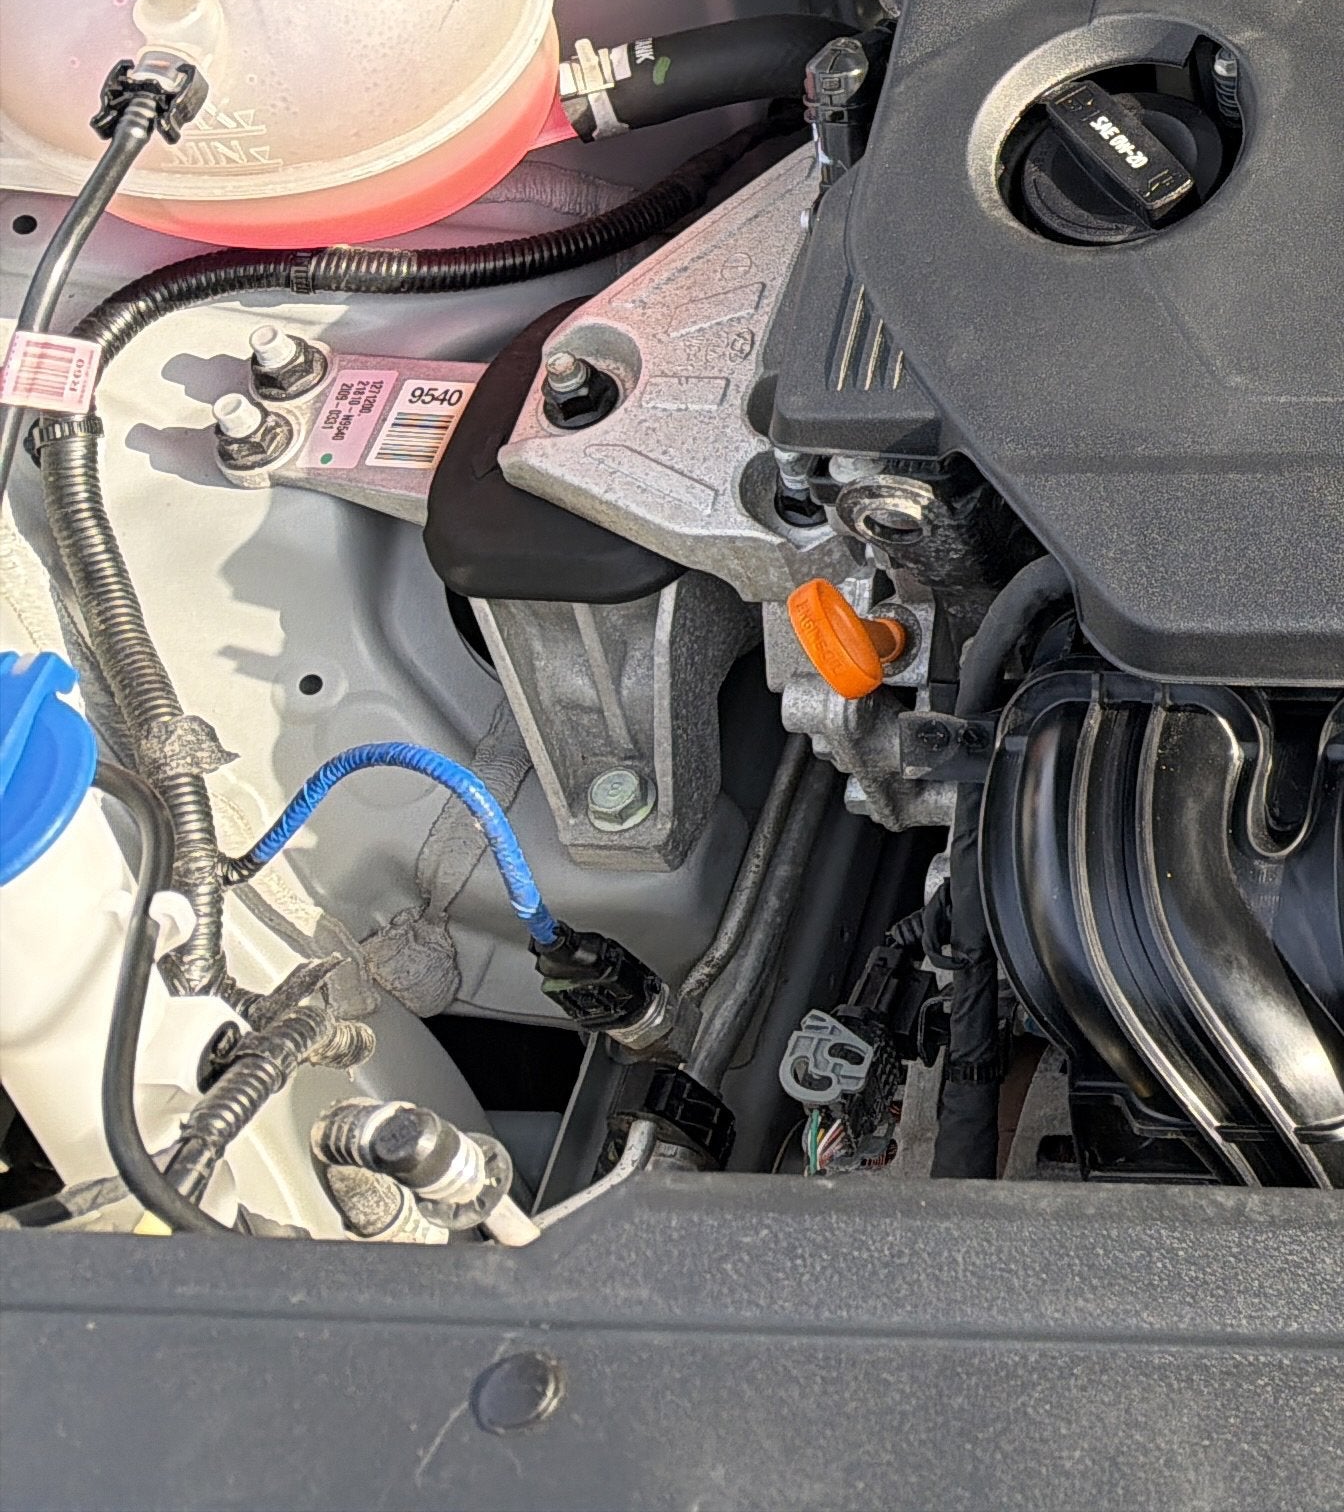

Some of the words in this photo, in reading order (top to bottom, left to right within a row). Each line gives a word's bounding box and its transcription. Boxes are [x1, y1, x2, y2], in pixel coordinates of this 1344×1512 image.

[635, 37, 655, 64] ANK
[1089, 115, 1120, 140] SAE
[1109, 134, 1149, 169] 0W-20
[408, 386, 464, 407] 9540
